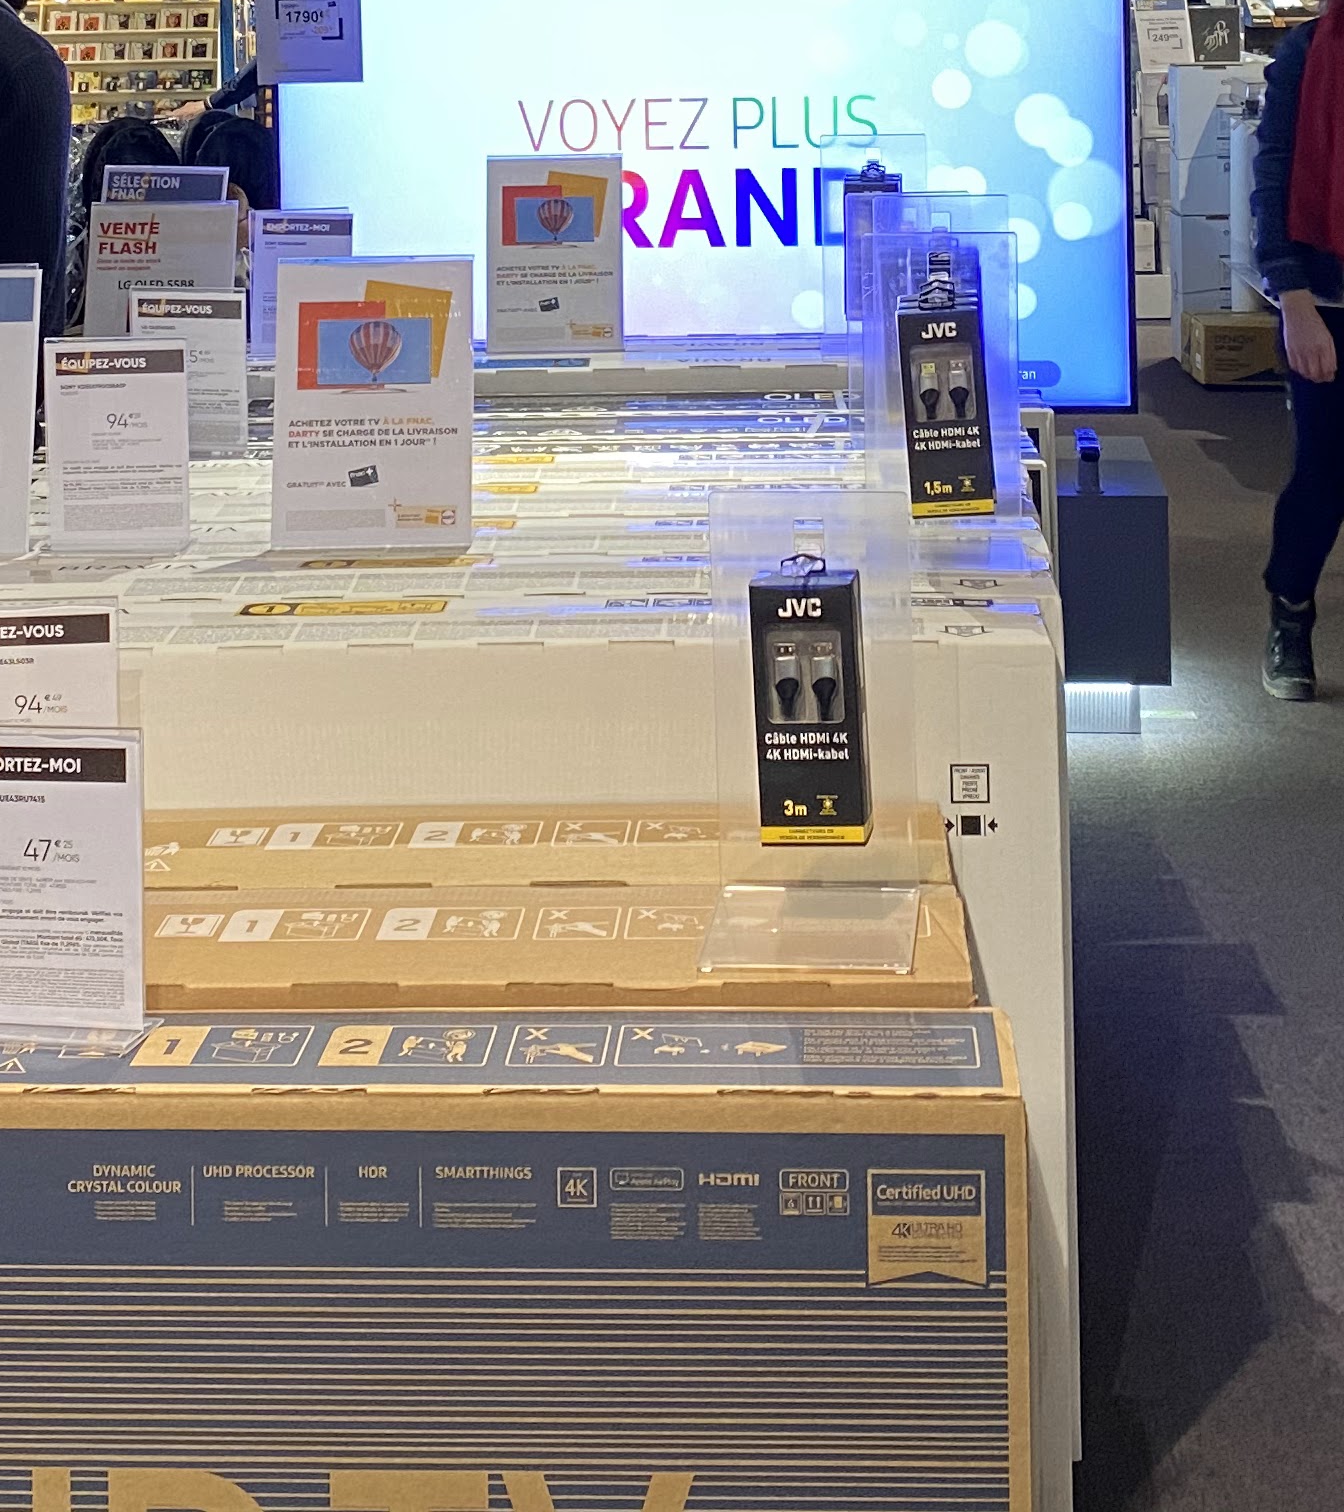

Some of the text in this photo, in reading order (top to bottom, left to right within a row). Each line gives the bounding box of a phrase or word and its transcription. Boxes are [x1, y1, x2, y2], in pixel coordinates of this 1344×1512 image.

[519, 95, 878, 151] VOYEZ PLUS
[111, 172, 181, 189] SÉLECTION
[110, 188, 146, 201] FNAC
[621, 168, 846, 249] RAND
[99, 222, 161, 235] VENTE
[266, 220, 331, 234] EMPORTEZ-MOI
[98, 242, 157, 255] FLASH
[118, 280, 131, 290] LG
[141, 301, 213, 315] ÉQUIPEZ-VOUS
[921, 322, 957, 340] JVC
[60, 355, 147, 371] ÉQUIPEZ-VOUS
[288, 419, 332, 428] ACHETEZ
[334, 419, 365, 427] VOTRE
[367, 418, 380, 426] TV
[382, 416, 390, 426] À
[391, 418, 404, 426] LA
[288, 430, 320, 438] DARTY
[322, 429, 334, 438] SE
[336, 429, 375, 437] CHARGE
[392, 428, 405, 436] LA
[407, 427, 458, 436] LIVRAISON
[912, 426, 980, 439] Câble 4K
[288, 440, 299, 449] ET
[302, 439, 377, 448] L'INSTALLATION
[379, 439, 392, 447] EN
[914, 441, 927, 451] 4K
[923, 480, 953, 496] 1,5m
[777, 597, 823, 619] JVC
[42, 705, 68, 714] /MOIS
[764, 731, 798, 745] Câble
[831, 732, 849, 744] 4K
[765, 748, 782, 761] 4K
[783, 798, 808, 817] 3m
[423, 830, 449, 842] 2
[52, 853, 80, 863] /MOIS
[245, 918, 422, 933] 1 2
[161, 1037, 374, 1056] 1 2
[92, 1164, 157, 1178] DYNAMIC
[202, 1165, 316, 1179] UHD PROCESSOR
[358, 1165, 388, 1180] HDR
[434, 1165, 533, 1181] SMARTTHINGS
[67, 1180, 182, 1194] CRYSTAL COLOUR
[564, 1178, 588, 1197] 4K
[788, 1173, 841, 1189] FRONT
[876, 1184, 977, 1200] Certified UHD
